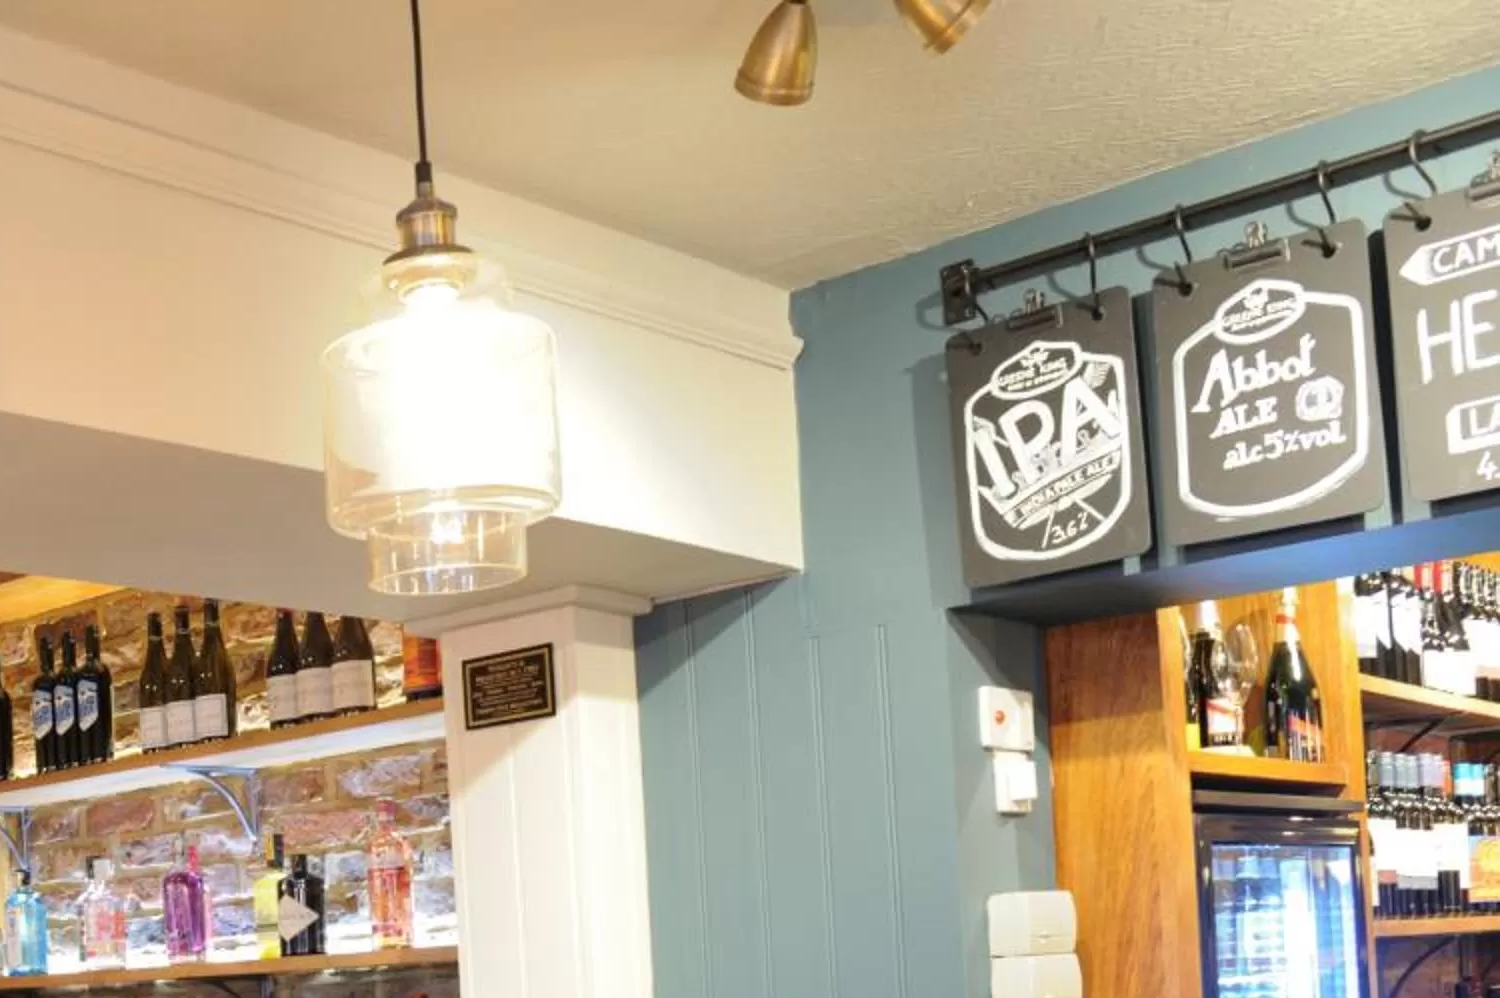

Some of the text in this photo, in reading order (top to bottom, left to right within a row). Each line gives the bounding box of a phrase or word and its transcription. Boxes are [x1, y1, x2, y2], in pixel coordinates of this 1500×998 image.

[1190, 332, 1316, 413] Abbot
[1417, 289, 1500, 385] HE
[974, 375, 1122, 499] IPA
[1209, 396, 1278, 439] ALE
